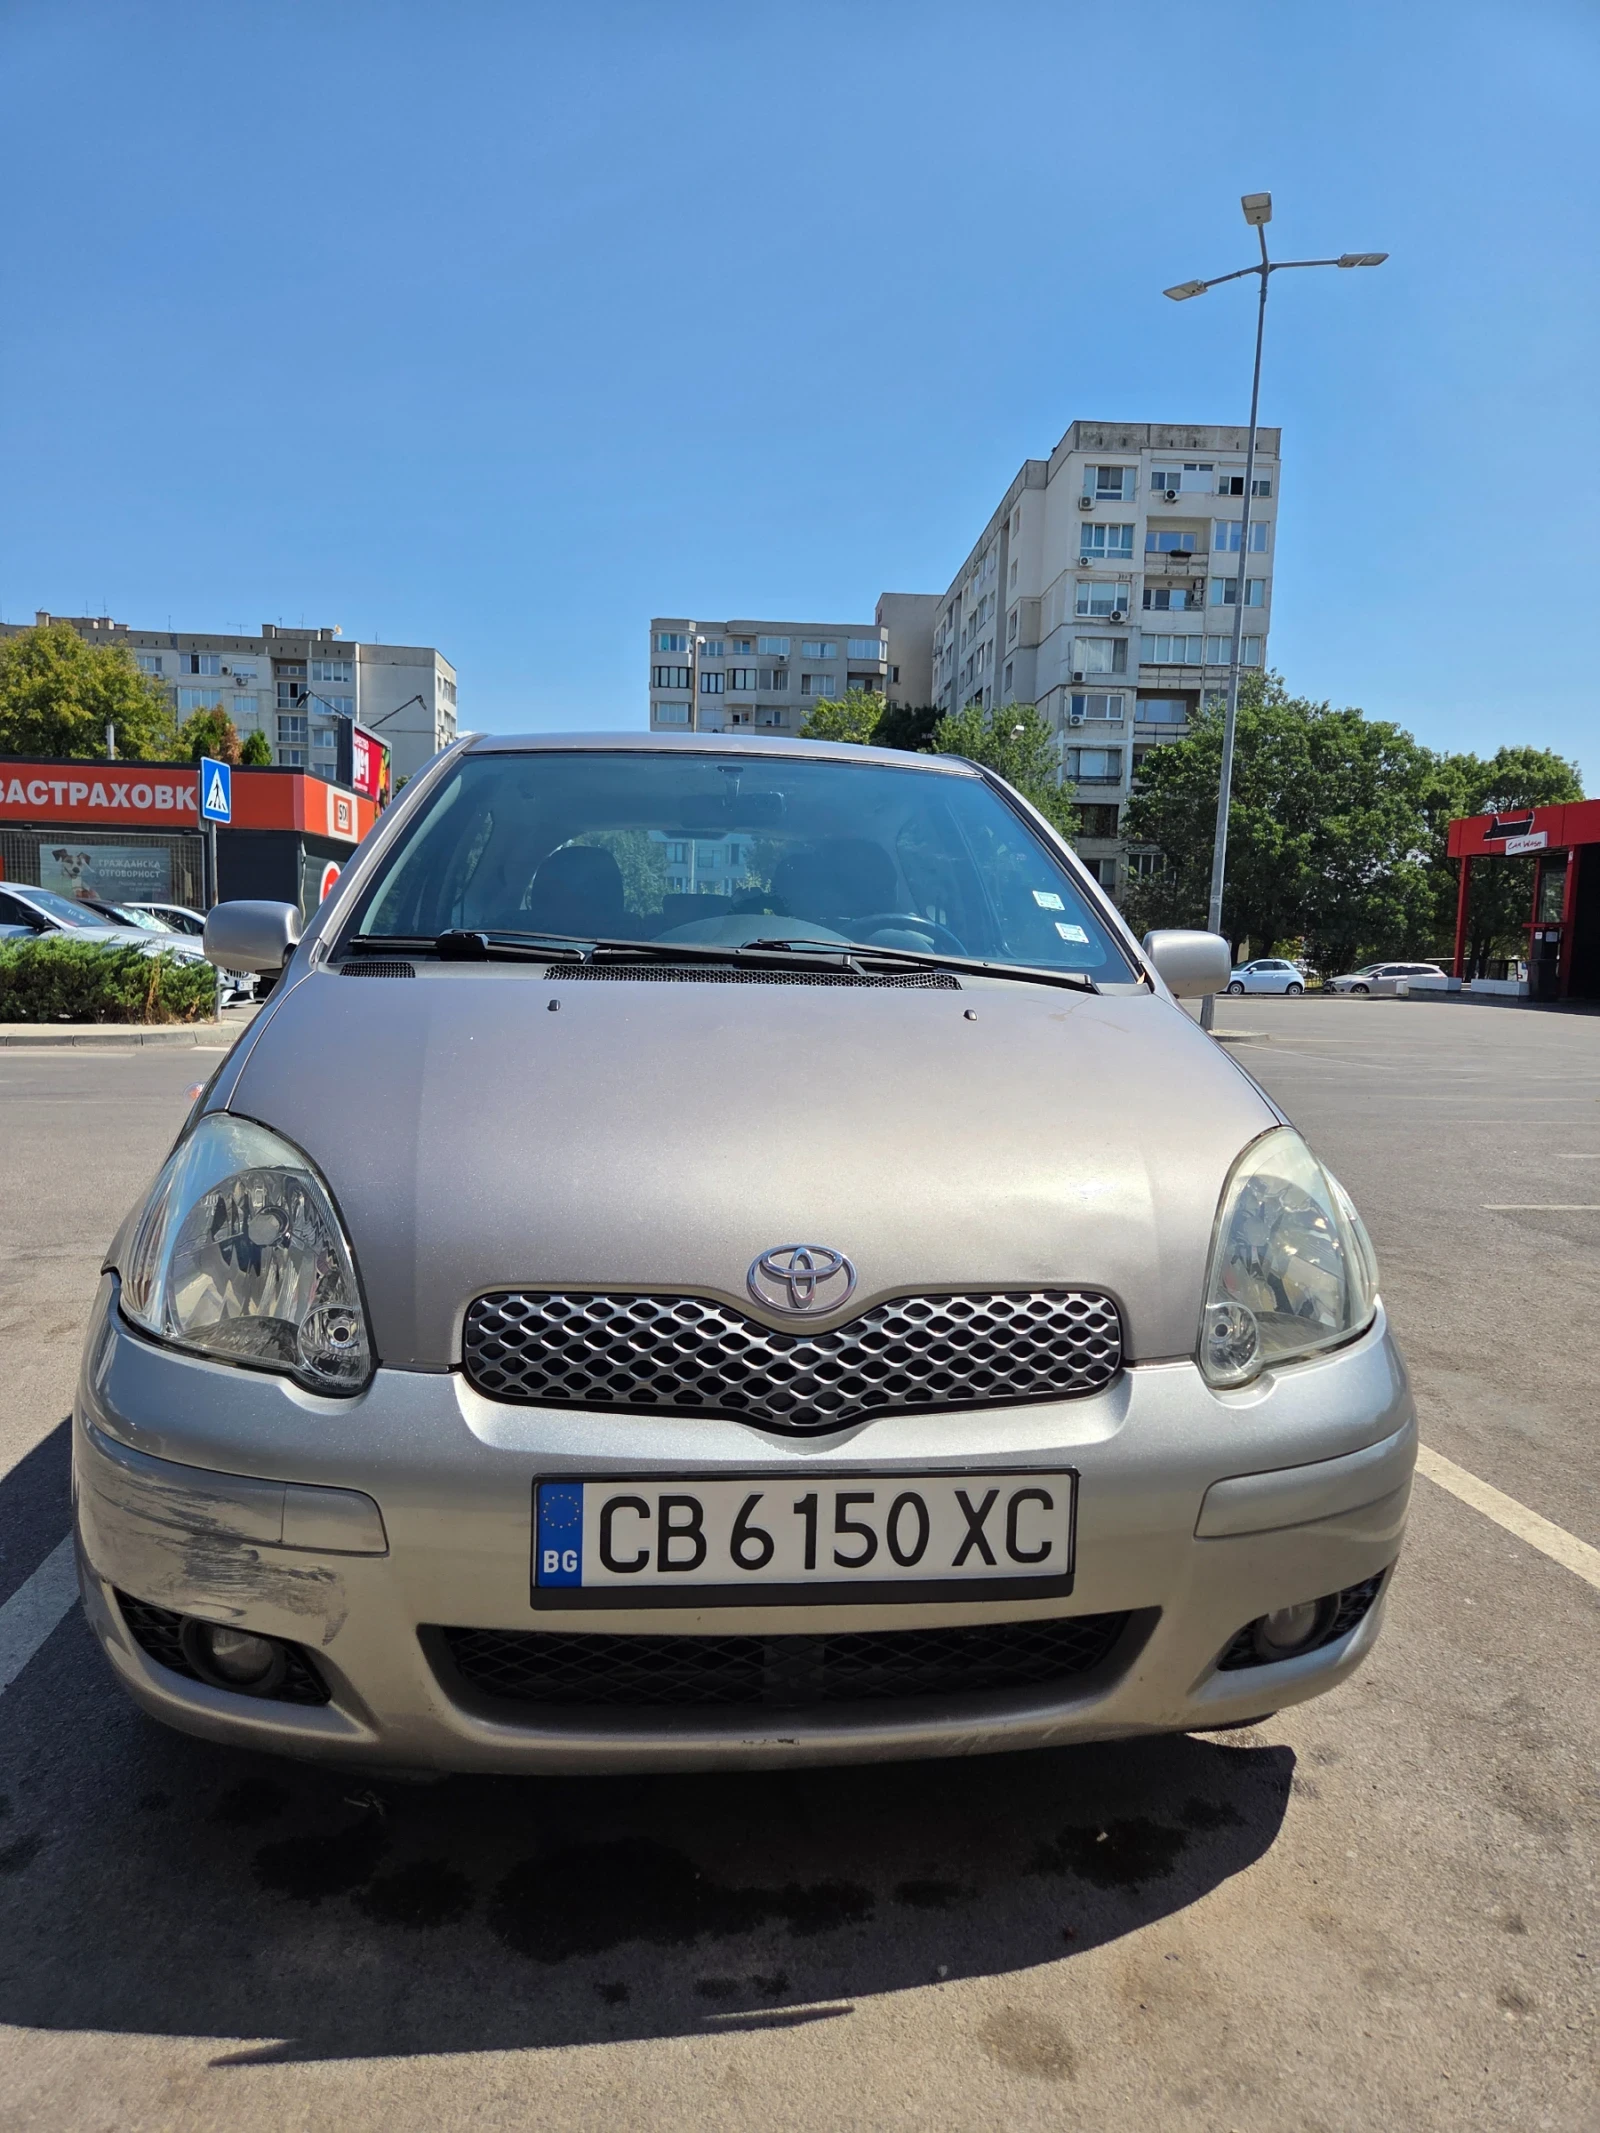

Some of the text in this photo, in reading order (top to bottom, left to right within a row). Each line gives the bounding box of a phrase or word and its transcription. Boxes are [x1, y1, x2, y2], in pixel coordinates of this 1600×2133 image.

[0, 778, 198, 811] АСТРАХОВК
[99, 859, 161, 869] ГРАЖДАНСКА
[99, 868, 161, 878] ОТГОВОРНОСТ
[600, 1487, 1054, 1573] CB 6150 XC
[543, 1549, 578, 1573] BG
